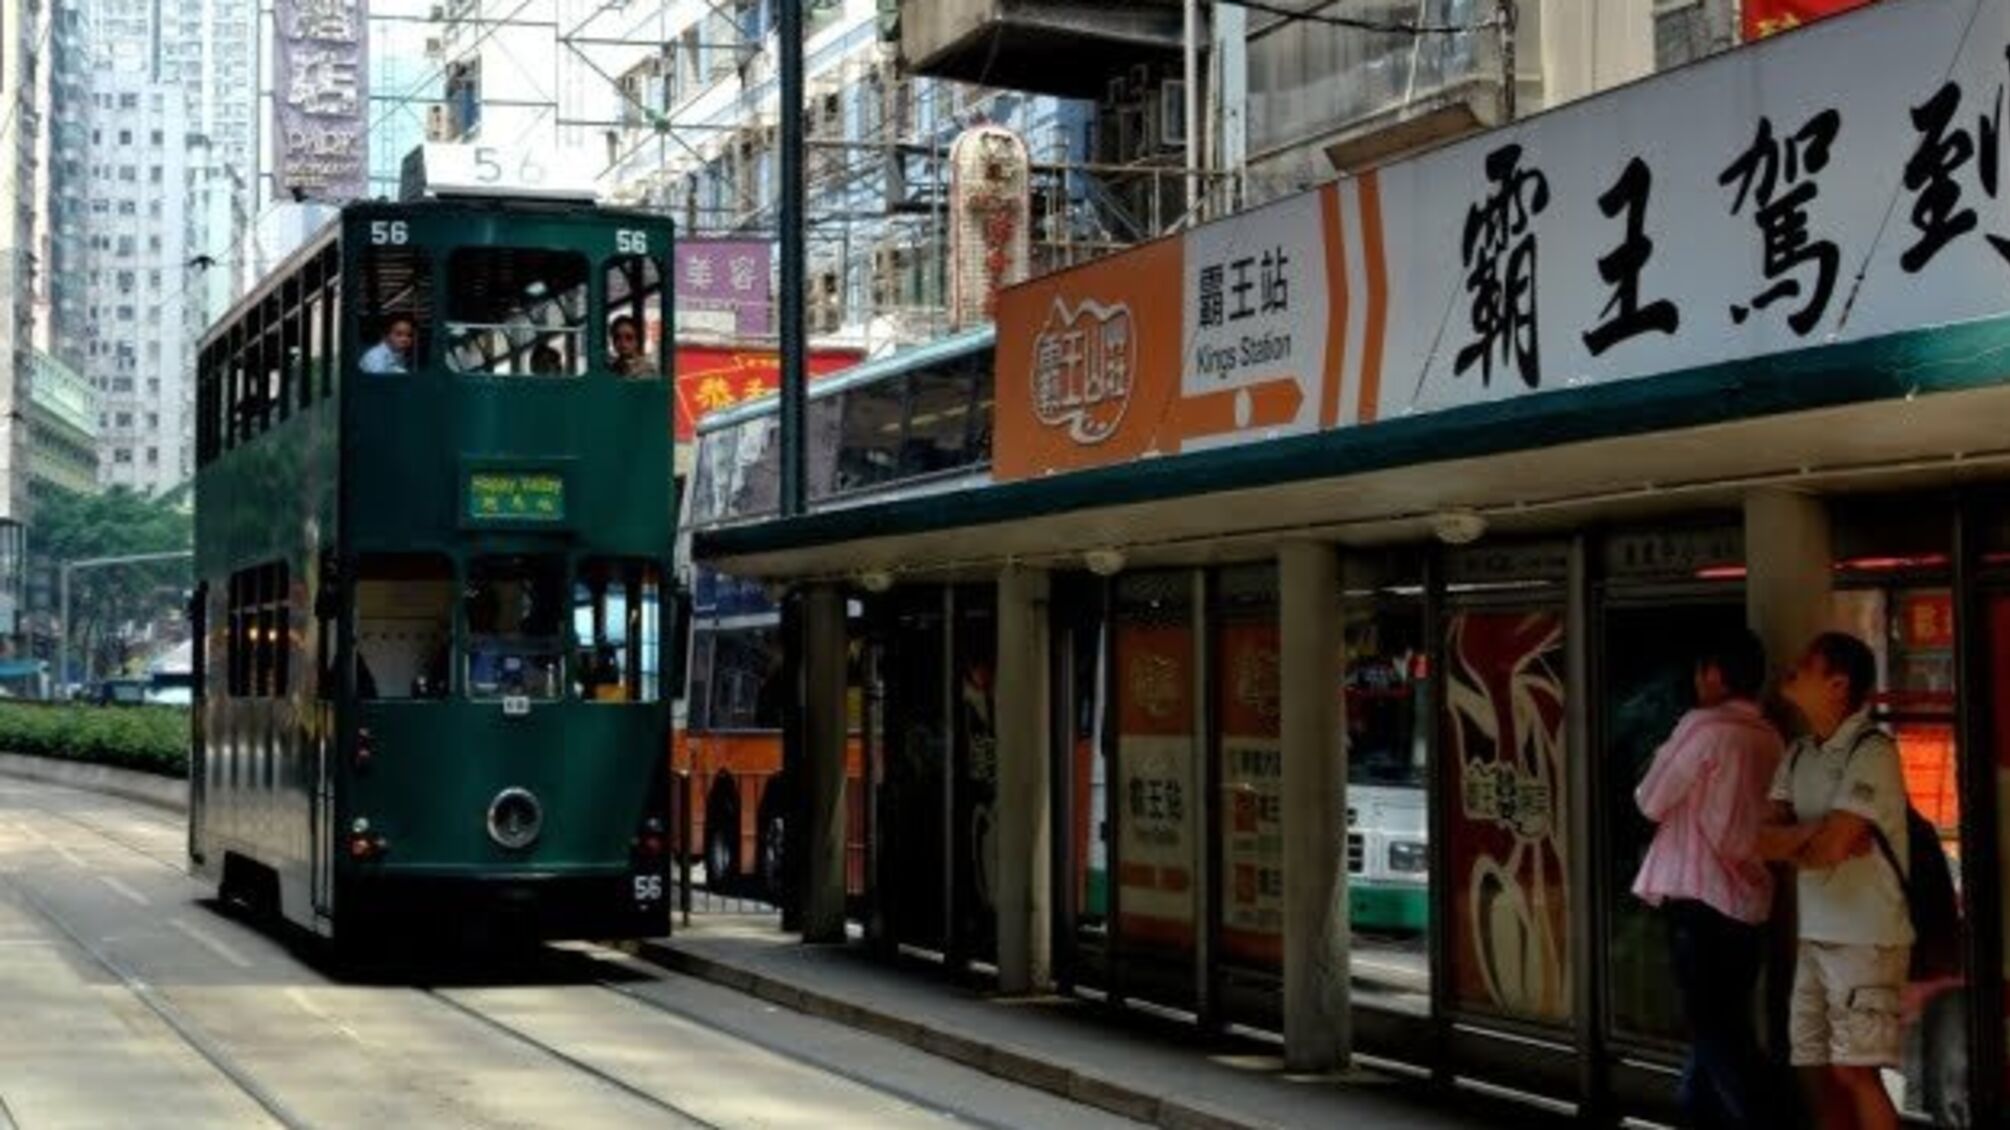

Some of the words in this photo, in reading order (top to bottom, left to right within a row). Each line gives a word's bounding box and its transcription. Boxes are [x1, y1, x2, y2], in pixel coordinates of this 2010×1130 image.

[474, 147, 549, 184] 56
[371, 219, 409, 245] 56
[1453, 44, 2010, 389] 霸王駕到
[615, 229, 648, 255] 56
[686, 255, 758, 291] 美容
[1199, 244, 1290, 331] 霸王站
[1196, 343, 1236, 379] Kings
[1239, 330, 1292, 368] Station
[633, 875, 663, 901] 56
